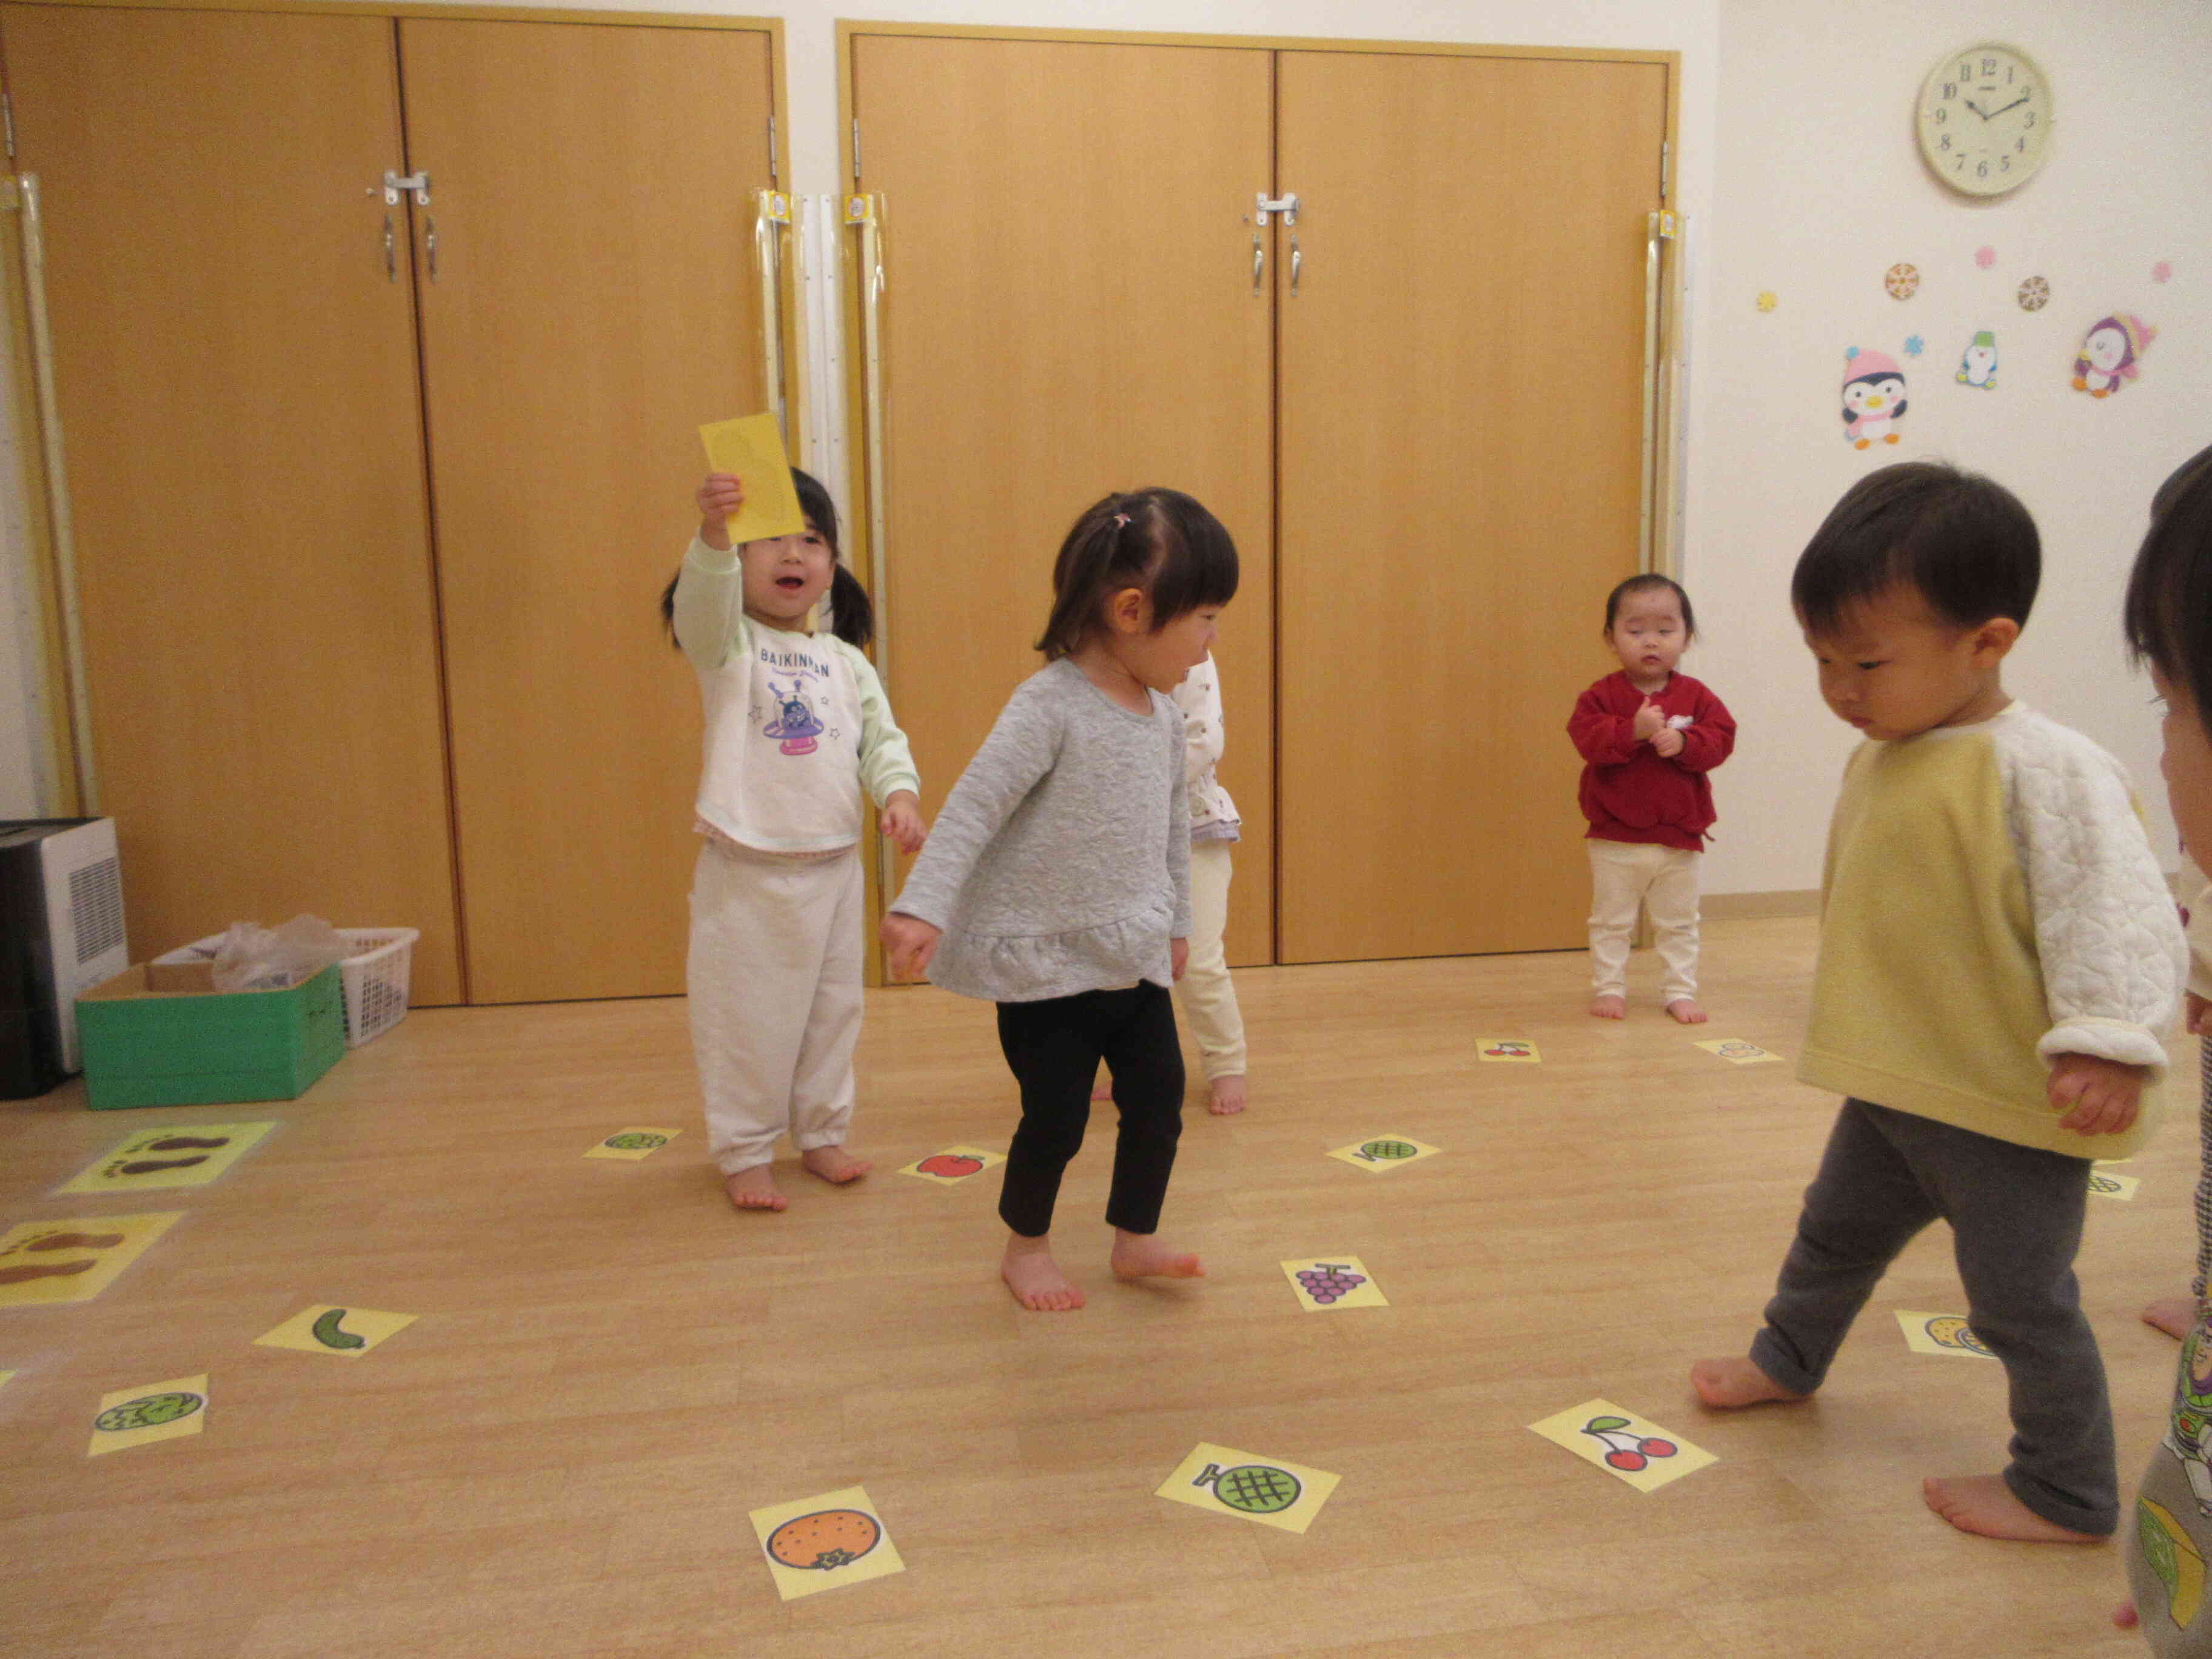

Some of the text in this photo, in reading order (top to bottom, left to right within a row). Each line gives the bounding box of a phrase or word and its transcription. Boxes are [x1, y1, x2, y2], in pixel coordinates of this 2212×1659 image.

[1960, 64, 1971, 82] 11
[1982, 58, 1996, 77] 12
[2008, 67, 2014, 84] 1
[1943, 82, 1957, 99] 10
[2020, 85, 2031, 103] 2
[1937, 108, 1946, 124] 9
[2023, 112, 2036, 129] 3
[1940, 134, 1951, 150] 8
[2016, 136, 2025, 153] 4
[1956, 153, 1966, 170] 7
[1977, 161, 1987, 178] 6
[2001, 155, 2009, 172] 5
